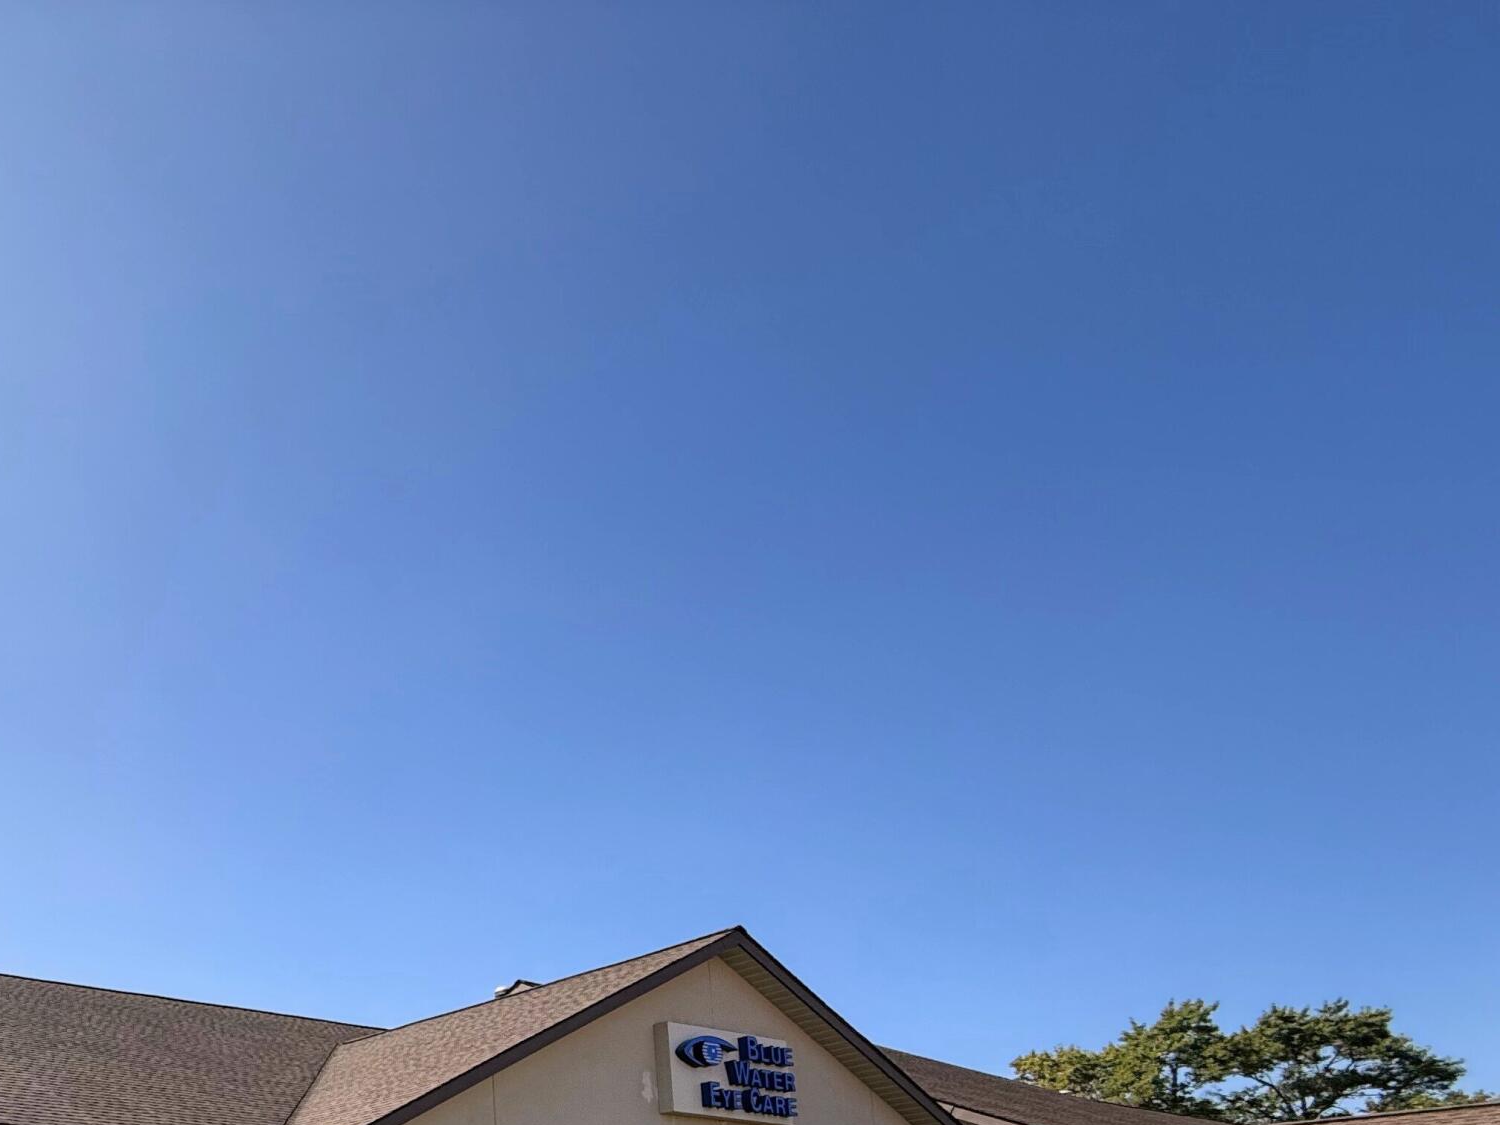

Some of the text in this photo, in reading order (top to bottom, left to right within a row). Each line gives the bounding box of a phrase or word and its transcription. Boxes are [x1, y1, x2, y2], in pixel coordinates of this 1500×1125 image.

[741, 1036, 794, 1066] BLUE
[727, 1060, 796, 1092] WATER
[704, 1082, 798, 1117] EYE CARE
